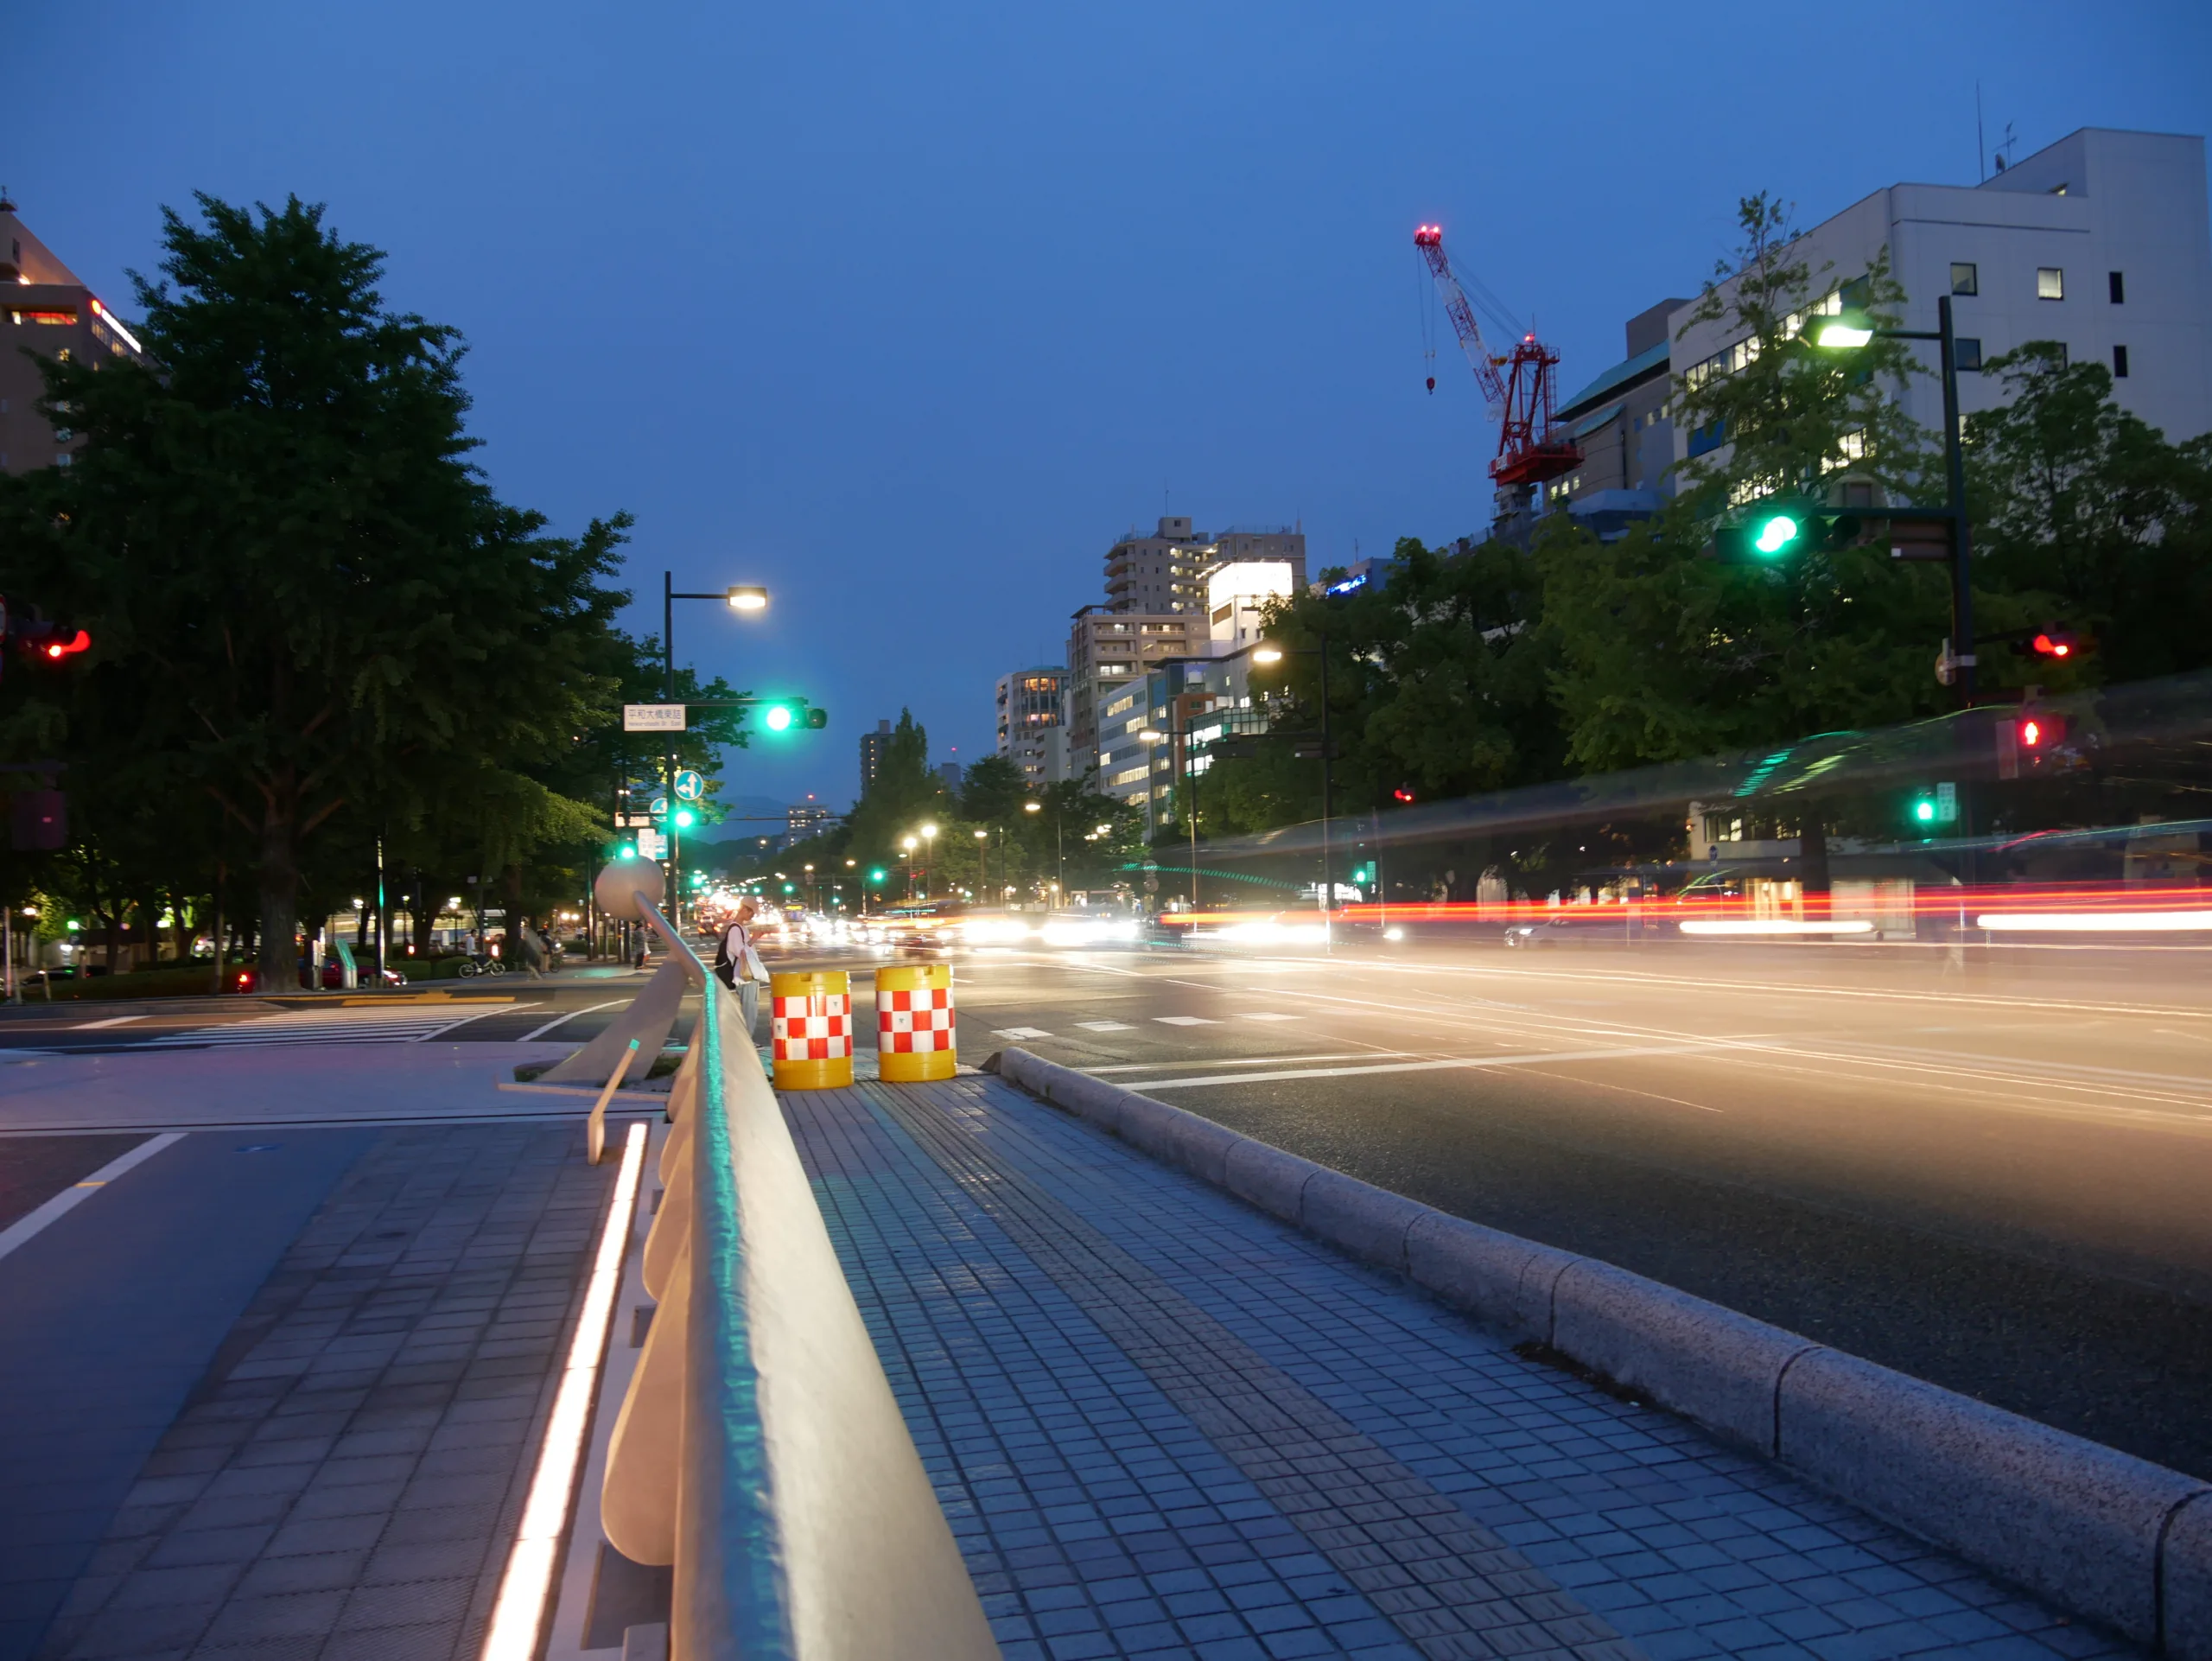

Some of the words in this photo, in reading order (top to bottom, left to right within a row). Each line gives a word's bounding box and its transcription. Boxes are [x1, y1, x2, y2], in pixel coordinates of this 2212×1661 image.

[628, 709, 681, 719] 平和大橋東詰
